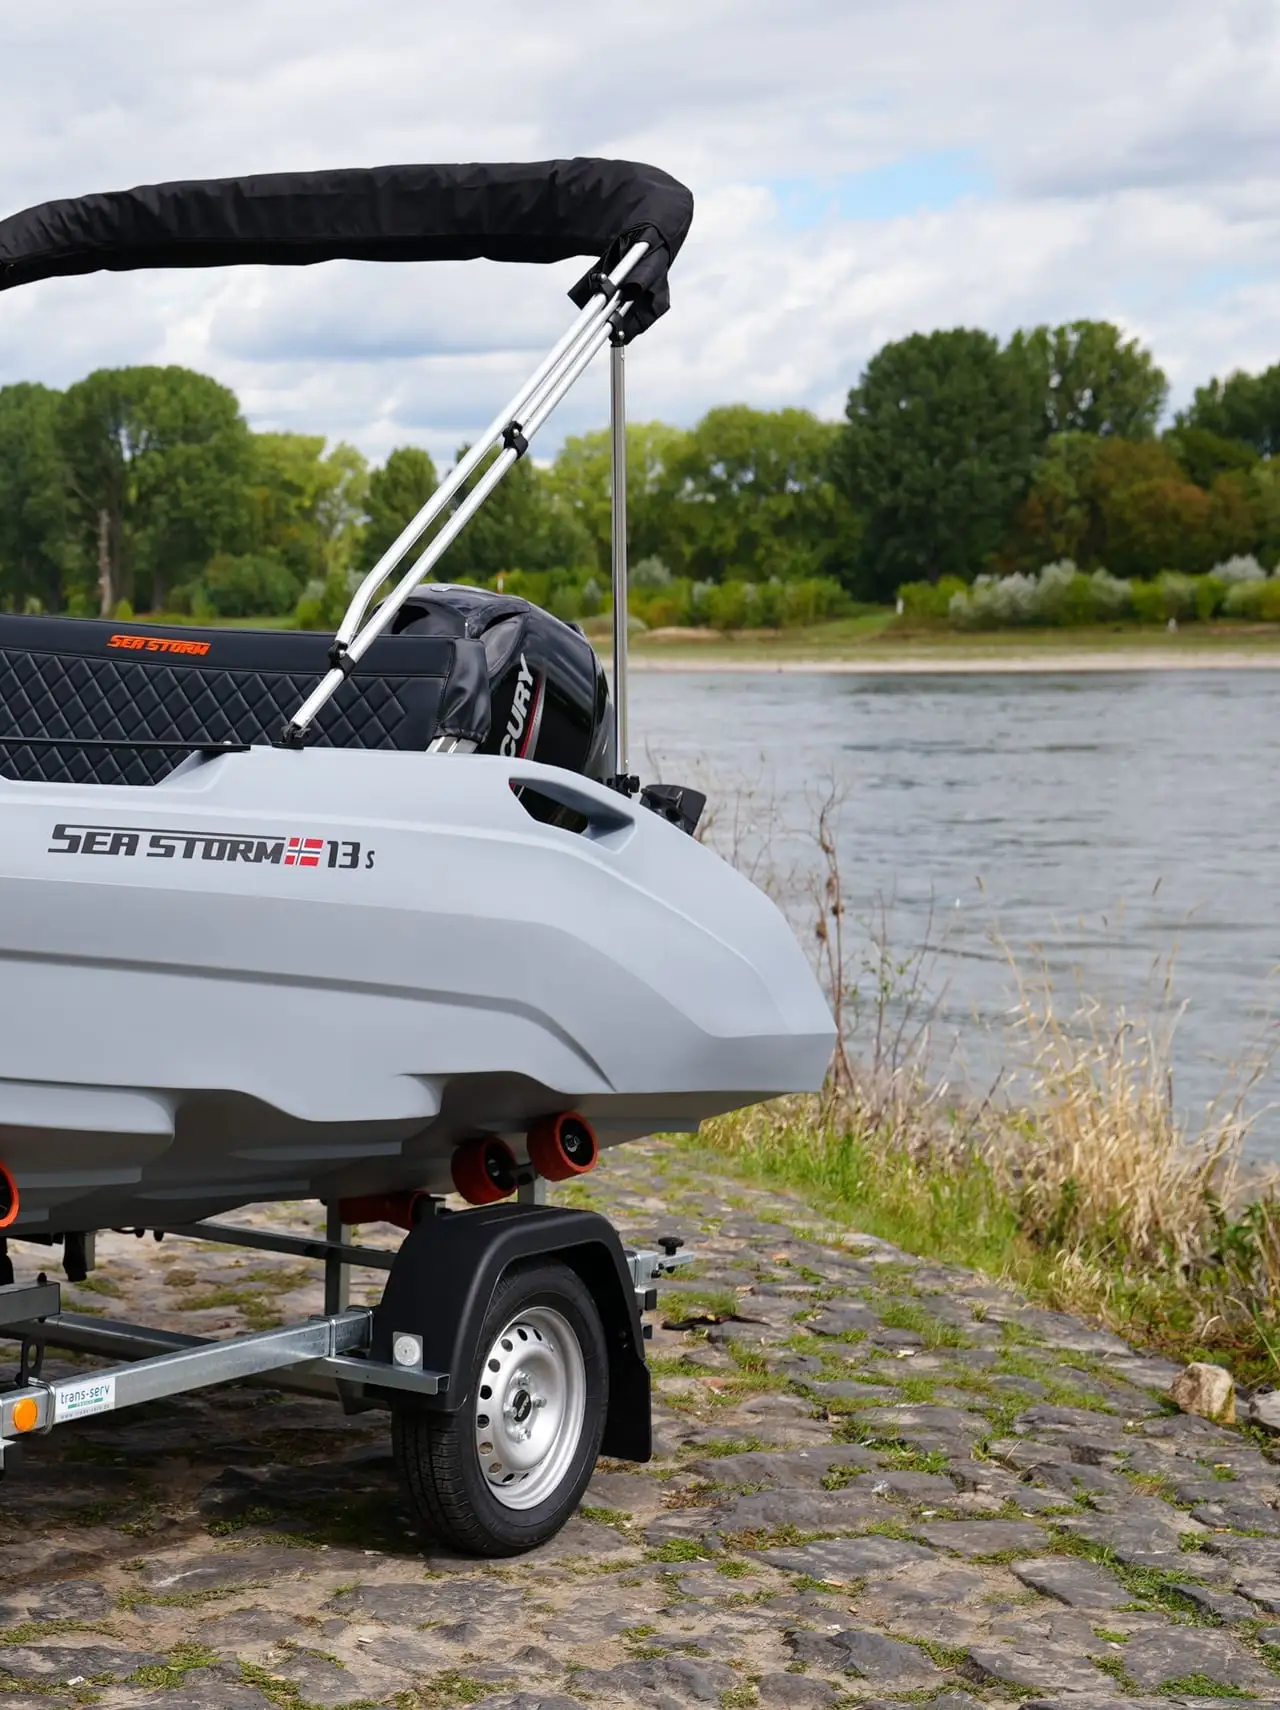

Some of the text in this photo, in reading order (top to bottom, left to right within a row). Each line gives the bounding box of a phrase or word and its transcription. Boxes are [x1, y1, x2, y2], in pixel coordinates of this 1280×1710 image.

[107, 634, 211, 655] SEA STORM
[48, 824, 139, 857] SEA
[147, 834, 285, 864] STORM
[60, 1385, 110, 1405] trans-serv
